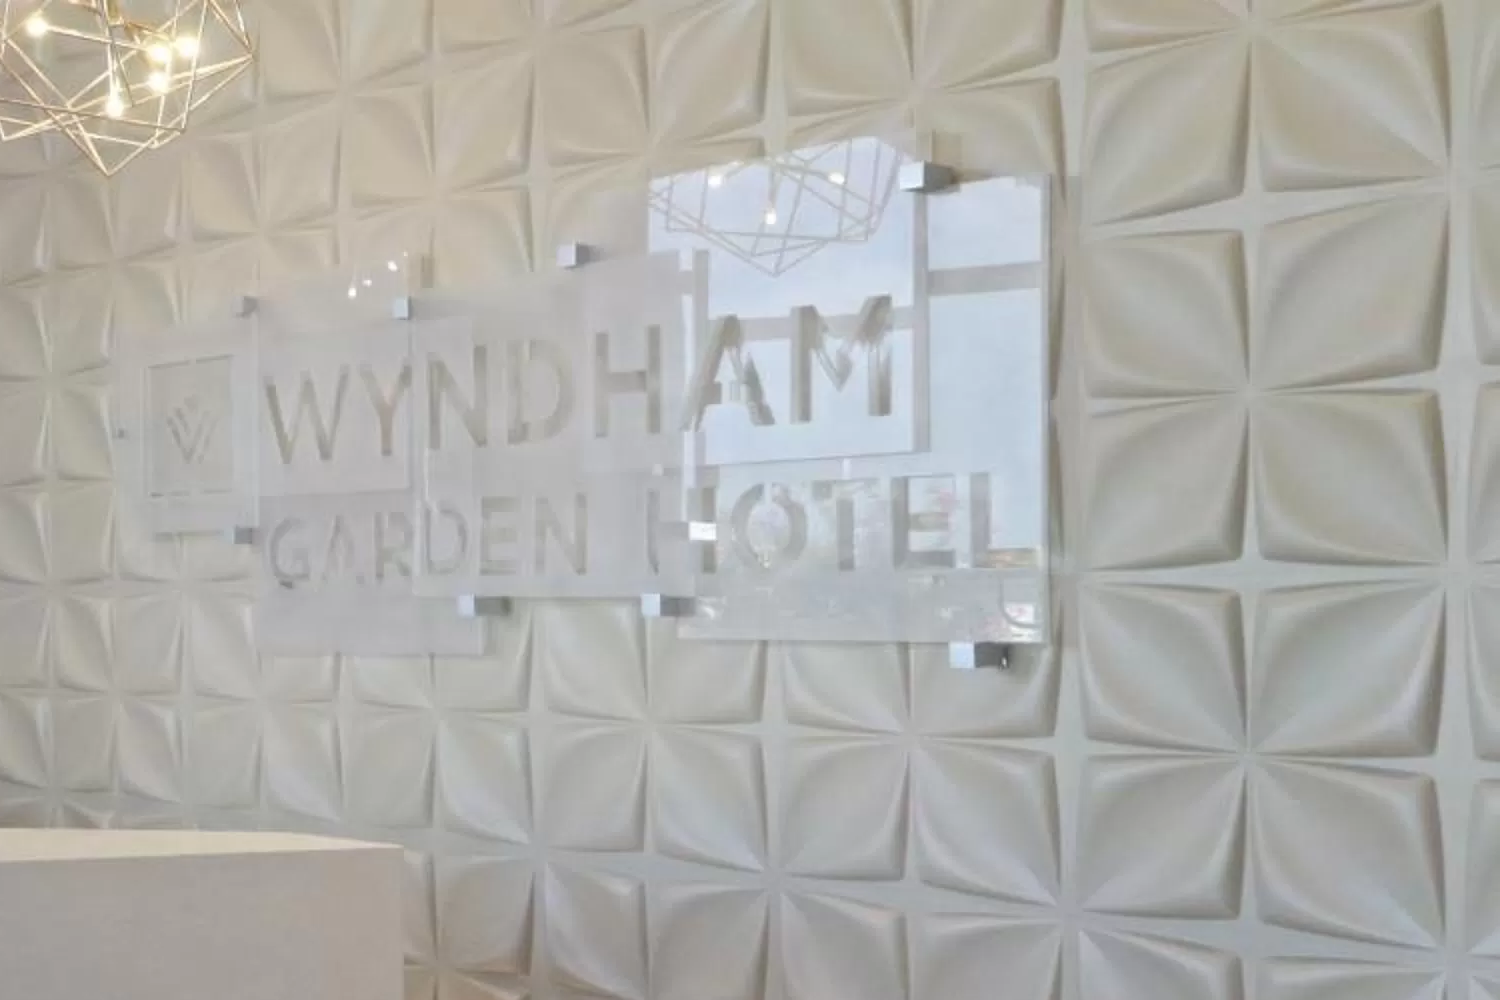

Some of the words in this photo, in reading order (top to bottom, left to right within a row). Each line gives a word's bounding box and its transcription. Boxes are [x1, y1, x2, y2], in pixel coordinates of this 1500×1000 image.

[263, 295, 893, 465] WYNDHAM
[266, 491, 589, 588] GARDEN
[647, 472, 1040, 575] HOTEL
